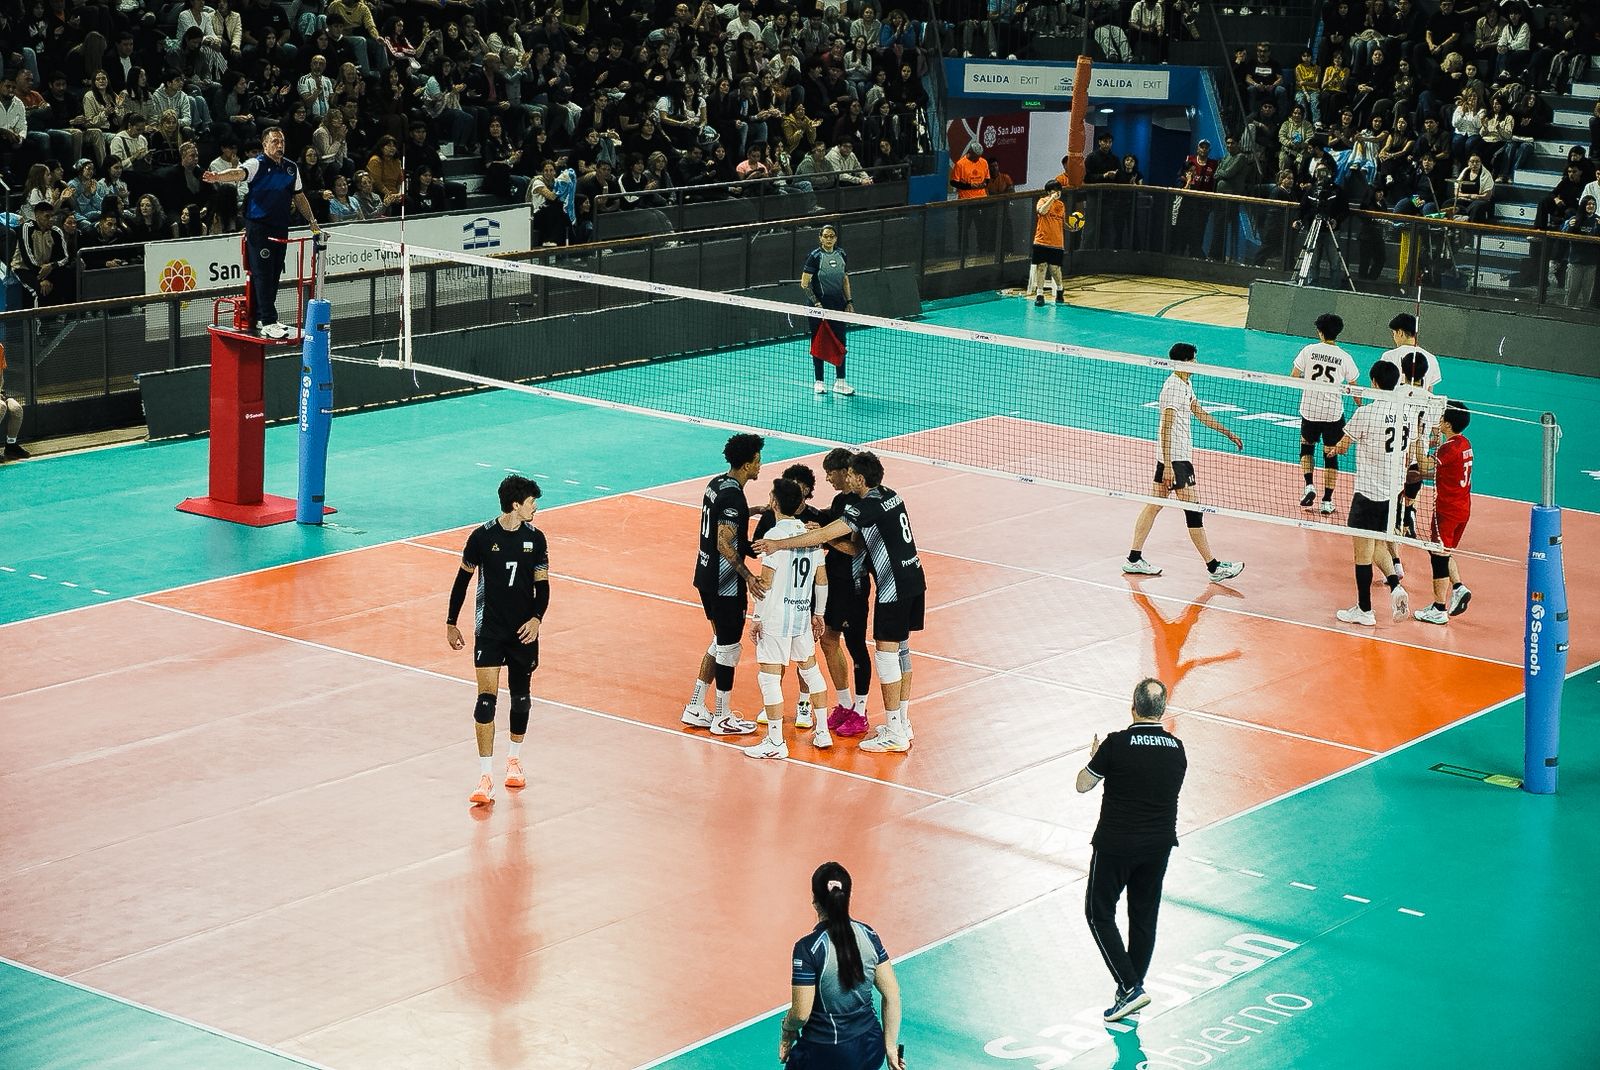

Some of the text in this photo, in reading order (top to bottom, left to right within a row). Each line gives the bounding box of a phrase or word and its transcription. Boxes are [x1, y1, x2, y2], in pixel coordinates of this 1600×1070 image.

[973, 74, 1039, 85] SALIDA EXIT
[1096, 79, 1162, 89] SALIDA EXIT
[997, 125, 1025, 136] San Juan
[1558, 145, 1565, 154] 5
[1519, 208, 1525, 216] 3
[1499, 241, 1505, 249] 2
[325, 248, 408, 267] nisterio de Turis
[209, 262, 241, 281] San
[1311, 352, 1343, 366] SHIMOKAWA
[1311, 363, 1337, 384] 25
[300, 388, 310, 432] Senoh
[899, 512, 913, 544] 8
[1532, 551, 1546, 559] FIVB
[505, 561, 518, 587] 7
[791, 557, 811, 588] 19
[1530, 620, 1543, 676] Senoh
[476, 650, 483, 661] 7
[1129, 734, 1179, 749] ARGENTINA
